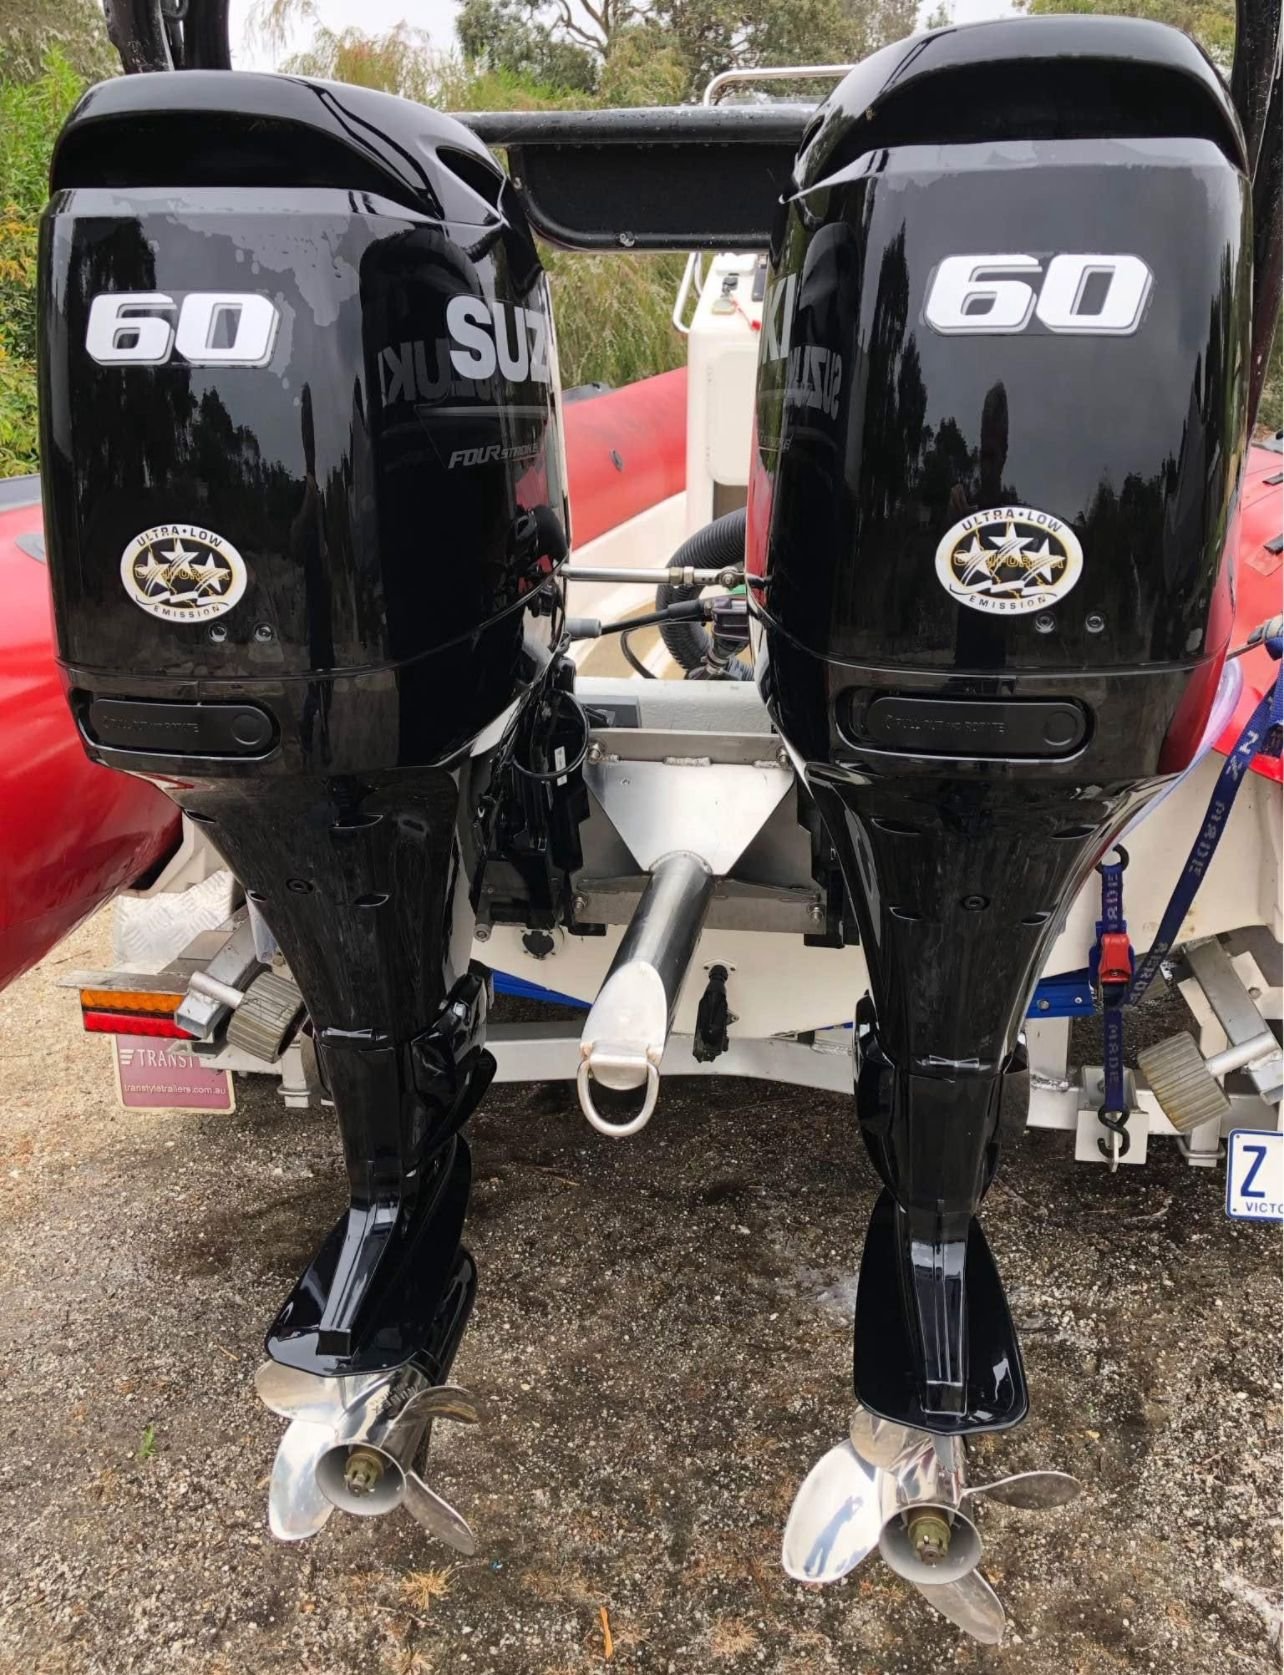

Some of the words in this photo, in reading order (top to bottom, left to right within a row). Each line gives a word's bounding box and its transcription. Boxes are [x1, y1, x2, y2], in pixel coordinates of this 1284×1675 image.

[924, 254, 1154, 337] 60
[85, 292, 280, 368] 60
[961, 508, 1015, 532] ULTRA
[1027, 511, 1063, 533] LOW
[136, 525, 181, 548] ULTRA
[190, 527, 223, 548] LOW
[153, 604, 221, 619] EMISSION
[969, 594, 1047, 611] EMISSION
[1240, 1145, 1267, 1198] Z
